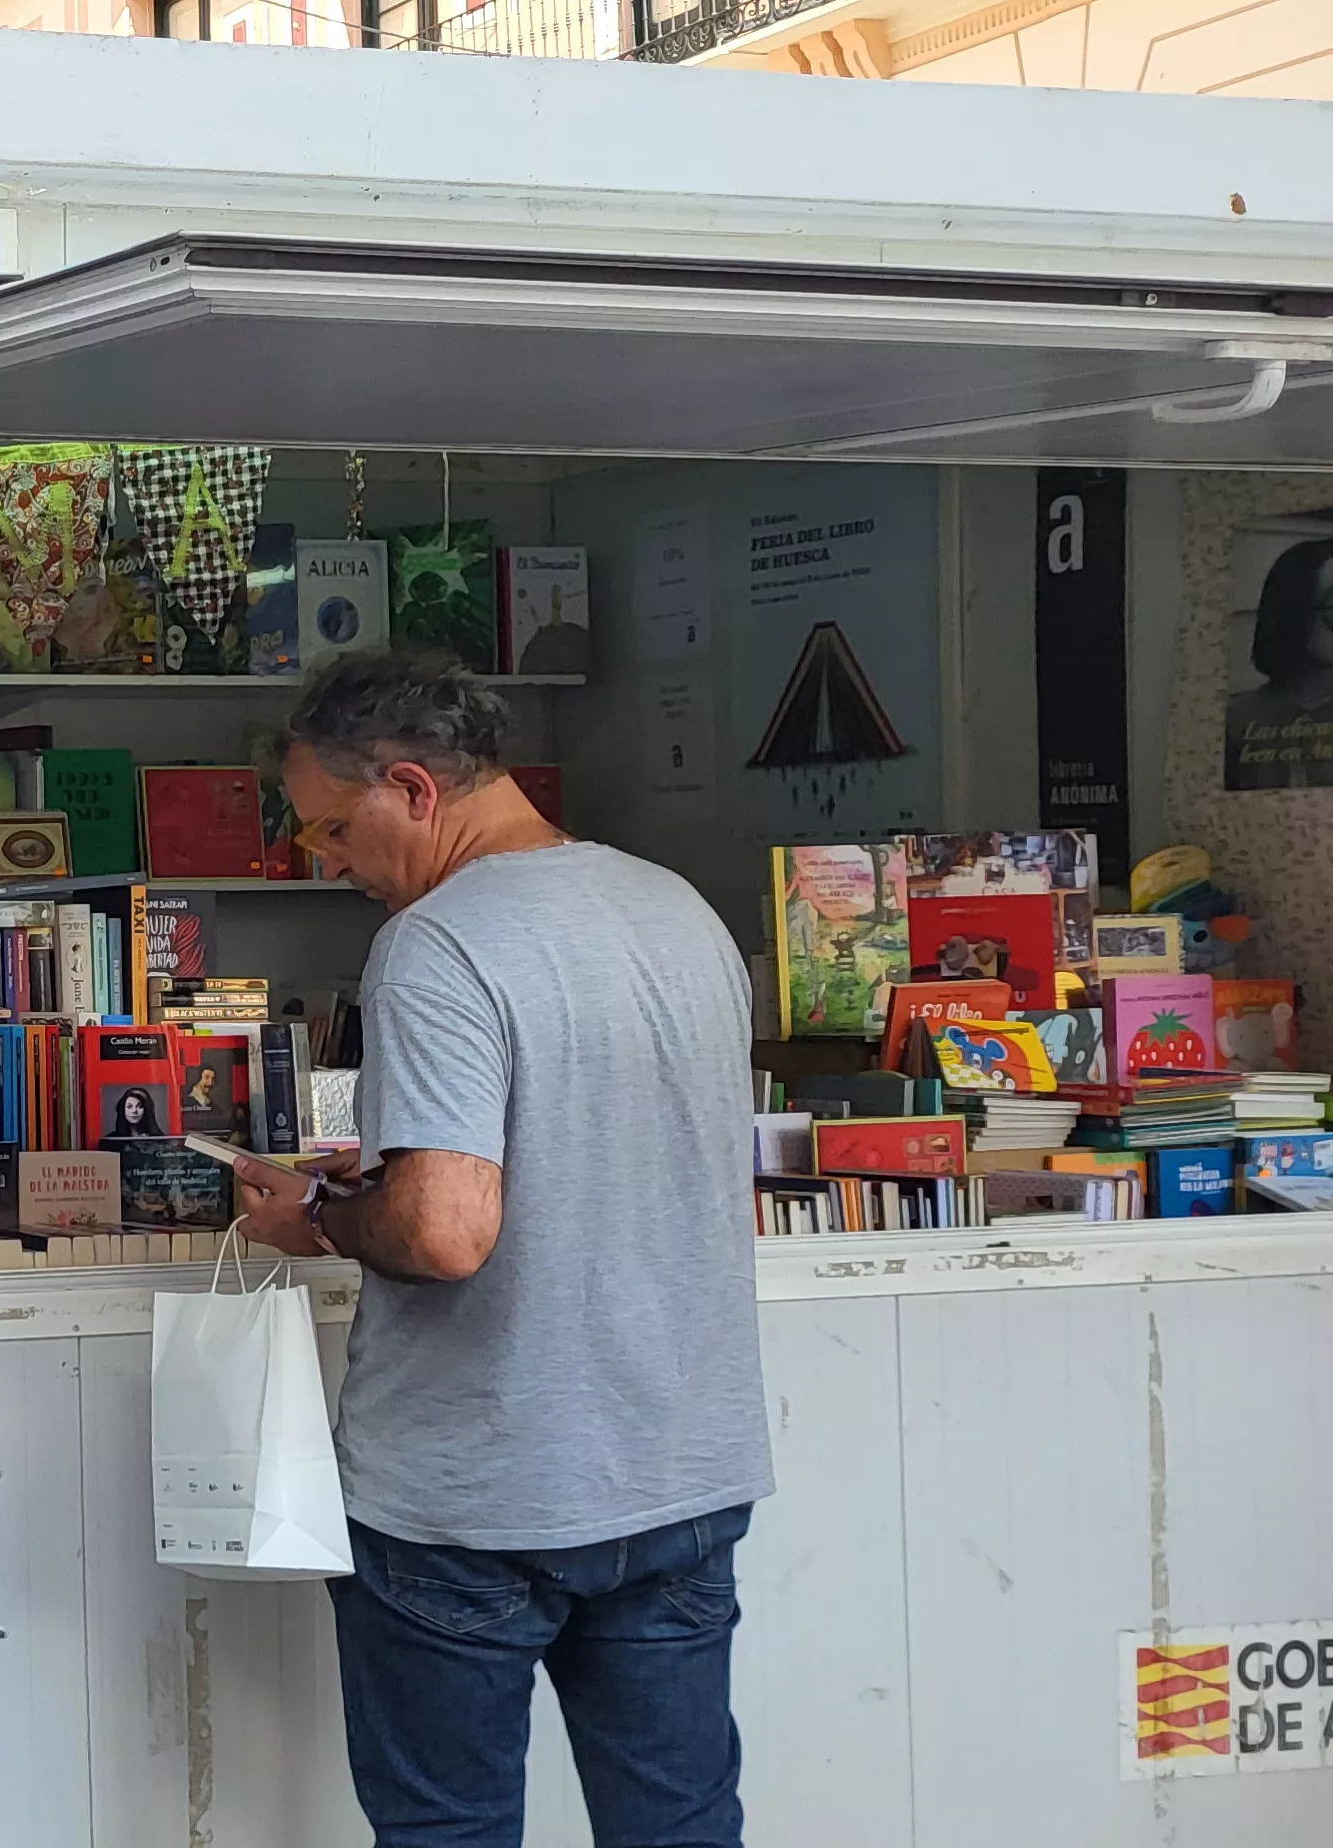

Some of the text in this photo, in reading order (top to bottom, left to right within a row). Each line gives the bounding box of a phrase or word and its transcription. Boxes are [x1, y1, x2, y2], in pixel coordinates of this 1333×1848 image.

[751, 519, 875, 551] FERIA DEL LIBRO
[1047, 495, 1084, 575] a
[306, 559, 369, 578] ALICIA
[751, 548, 831, 572] DE HUESCA
[1050, 783, 1118, 805] ANÓNIMA
[134, 896, 144, 933] TAXI
[71, 977, 84, 1003] Jane
[134, 1036, 157, 1045] Moran
[41, 1165, 96, 1179] EL MARIDO
[29, 1178, 110, 1192] DE LA MAESTRA
[1239, 1702, 1303, 1753] DE
